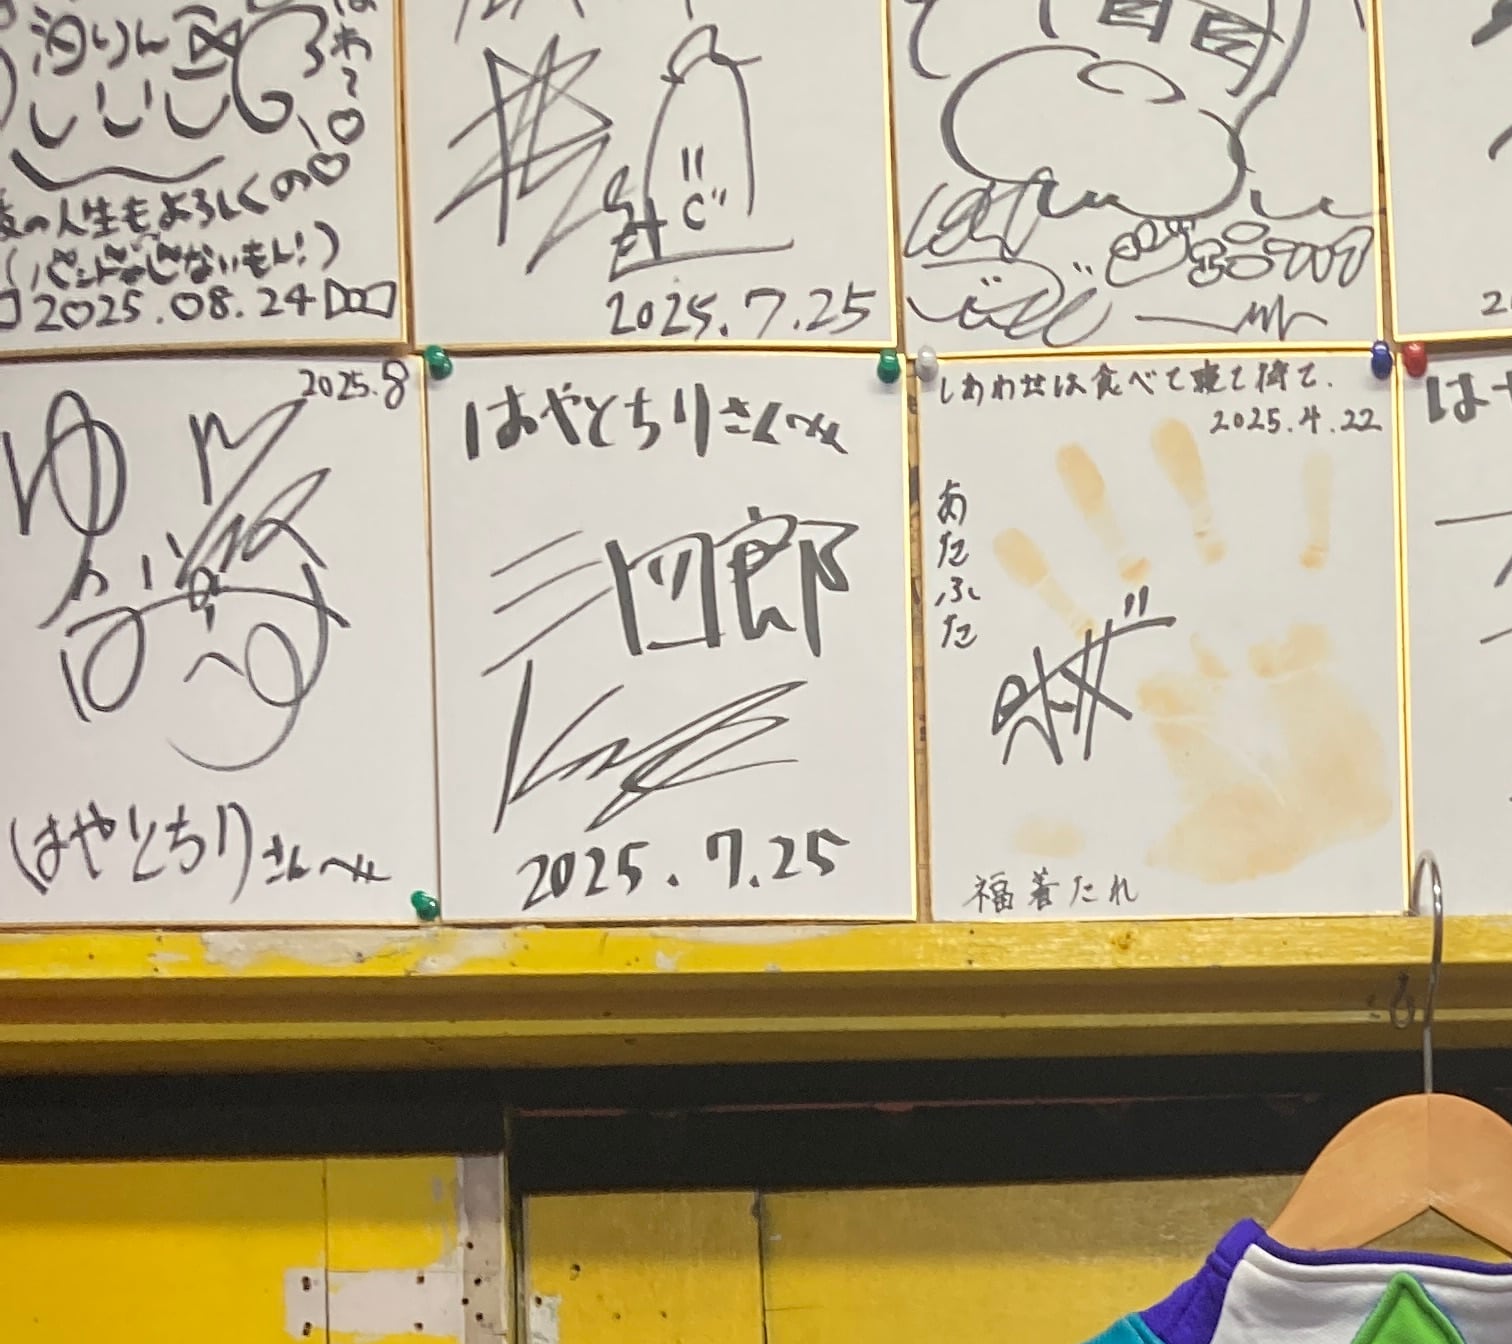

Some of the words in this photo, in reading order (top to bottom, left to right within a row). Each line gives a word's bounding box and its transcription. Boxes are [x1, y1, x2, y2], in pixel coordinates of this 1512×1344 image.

[606, 281, 876, 340] 2025.7.25
[1210, 405, 1382, 434] 2025.4.22
[482, 506, 859, 678] 三四郎
[935, 479, 981, 649] あたふた
[518, 828, 850, 911] 2025.7.25
